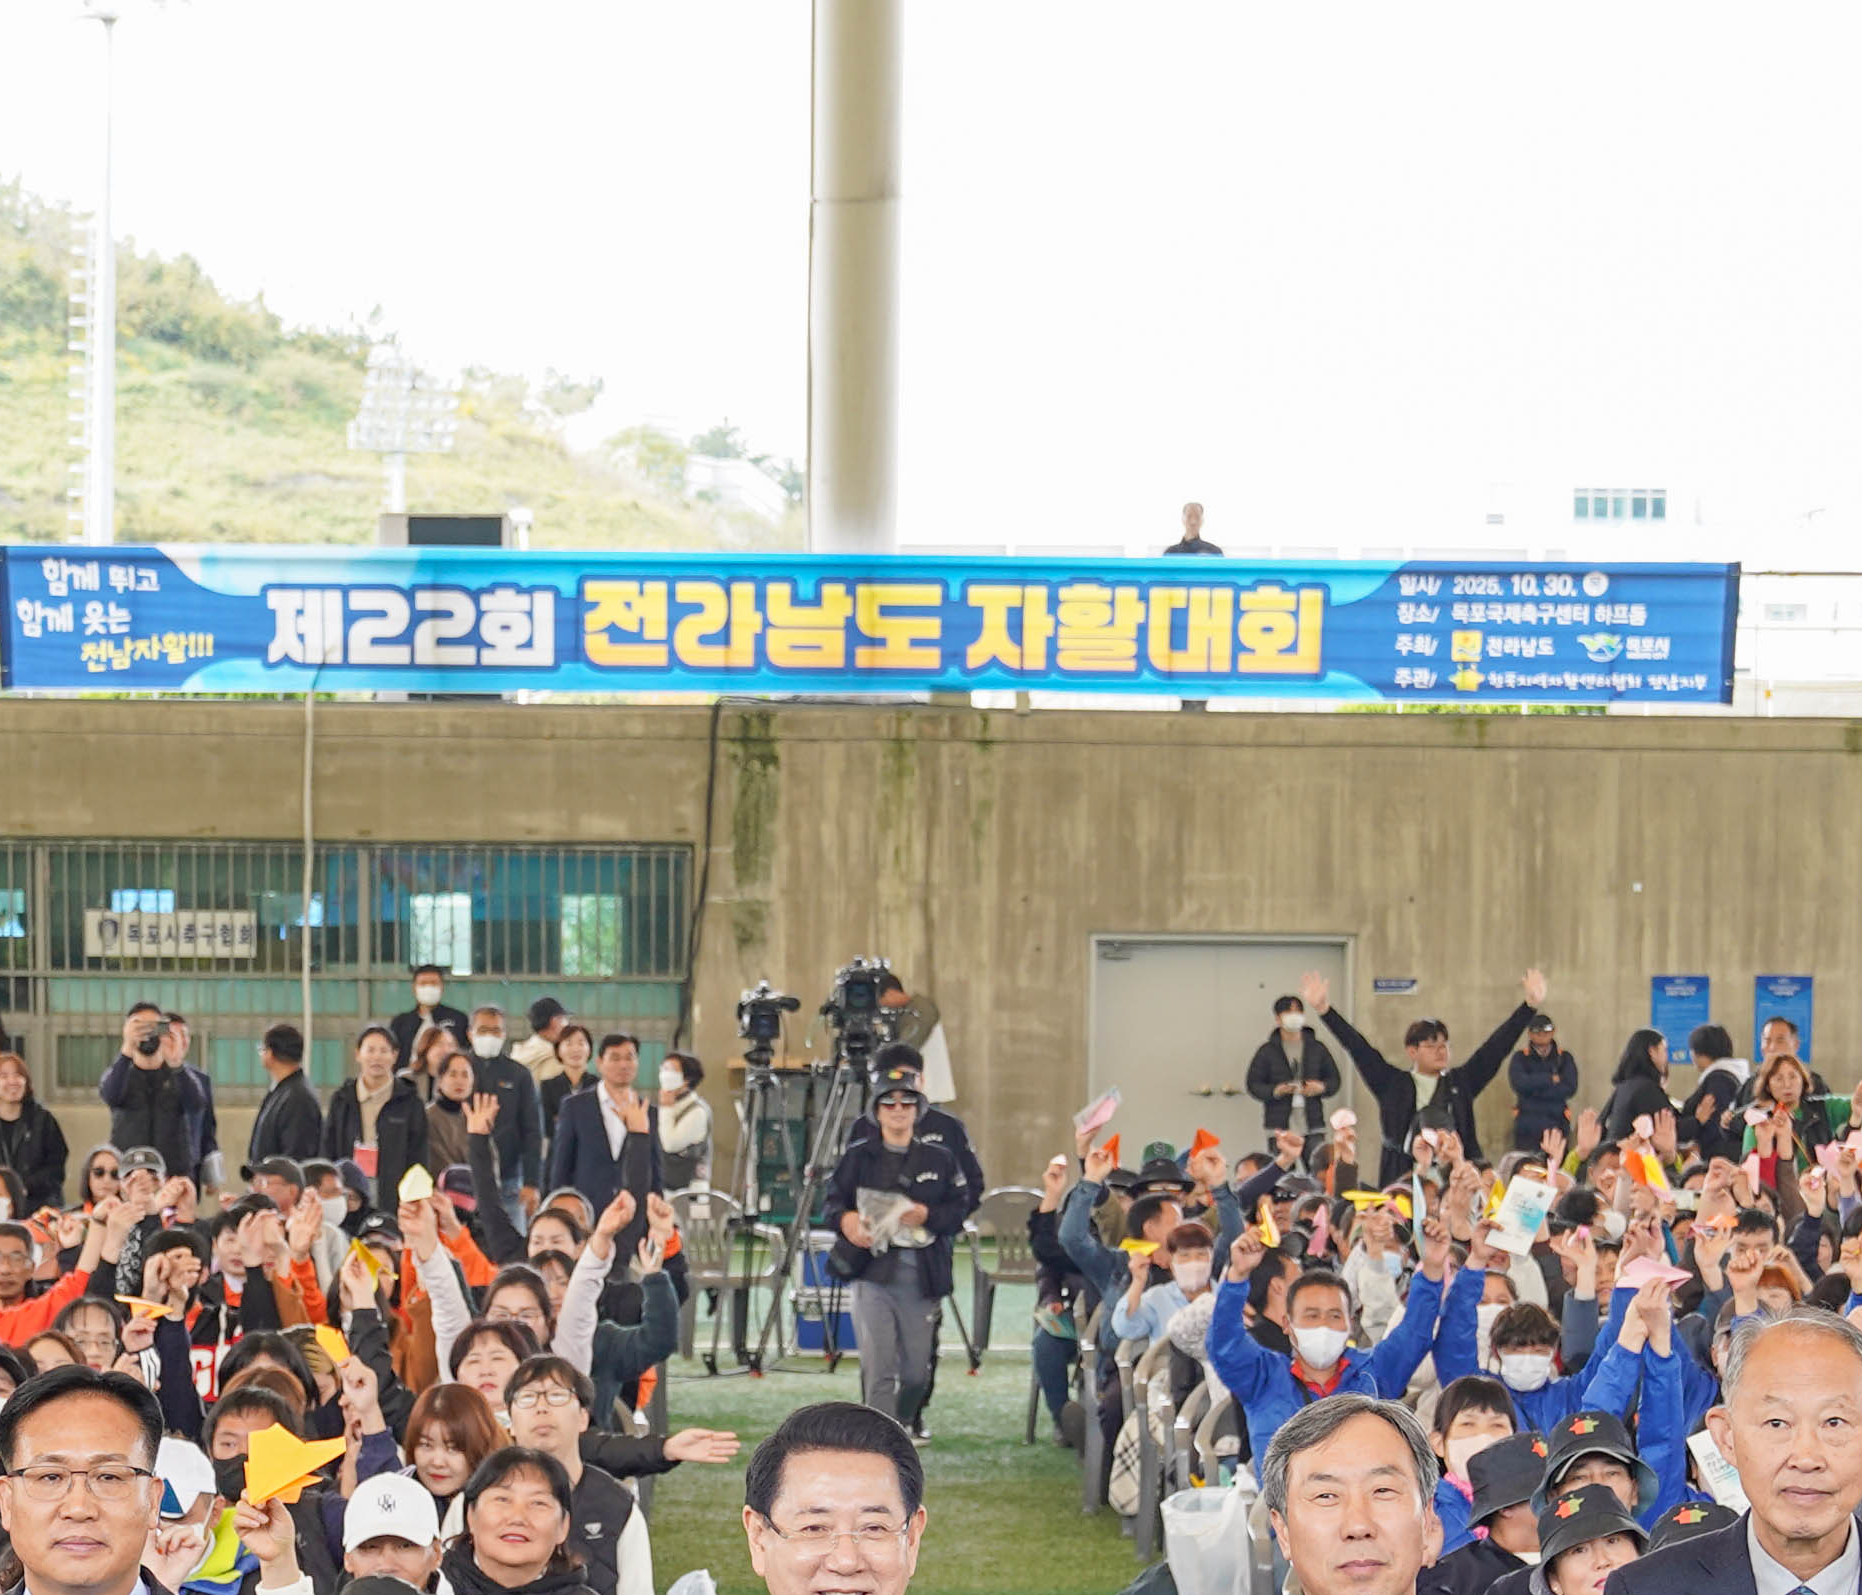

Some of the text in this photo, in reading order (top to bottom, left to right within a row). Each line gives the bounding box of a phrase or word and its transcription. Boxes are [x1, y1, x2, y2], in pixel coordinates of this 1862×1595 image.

[41, 557, 161, 597] 함께 뛰고
[1453, 575, 1504, 597] 2025.
[1511, 574, 1540, 597] 10.
[1543, 575, 1578, 598] 30.
[16, 597, 132, 639] 함께 웃는
[266, 580, 1322, 676] 제22회 전라남도 자활대회
[1397, 603, 1648, 627] 장소/ 목포국제축구센터 하프돔
[80, 632, 214, 673] 전남자활!!!
[1486, 636, 1555, 658] 전라남도
